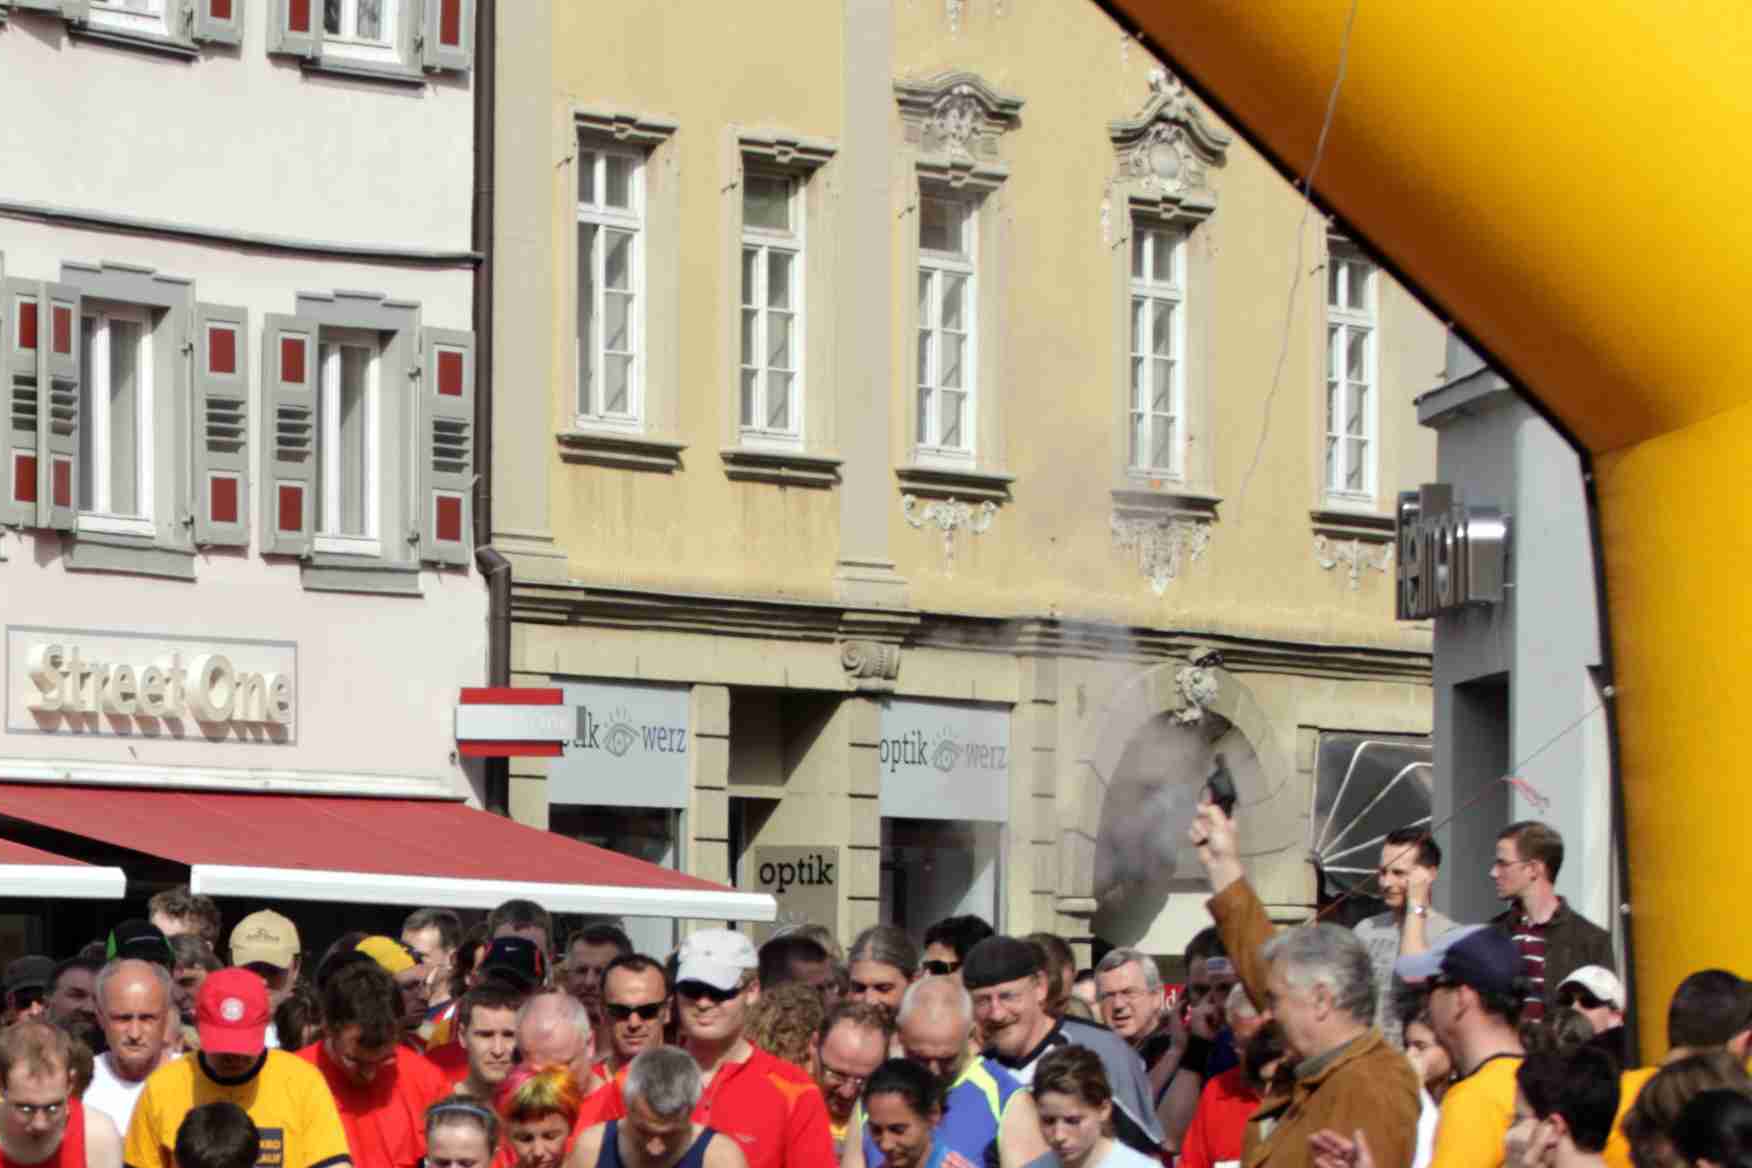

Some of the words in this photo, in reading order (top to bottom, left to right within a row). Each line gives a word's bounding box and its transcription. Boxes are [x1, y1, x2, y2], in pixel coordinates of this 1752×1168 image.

[28, 643, 187, 718] Street
[191, 654, 291, 724] One
[642, 725, 686, 753] werz
[879, 730, 929, 773] optik
[965, 743, 1008, 769] werz
[759, 854, 834, 894] optik
